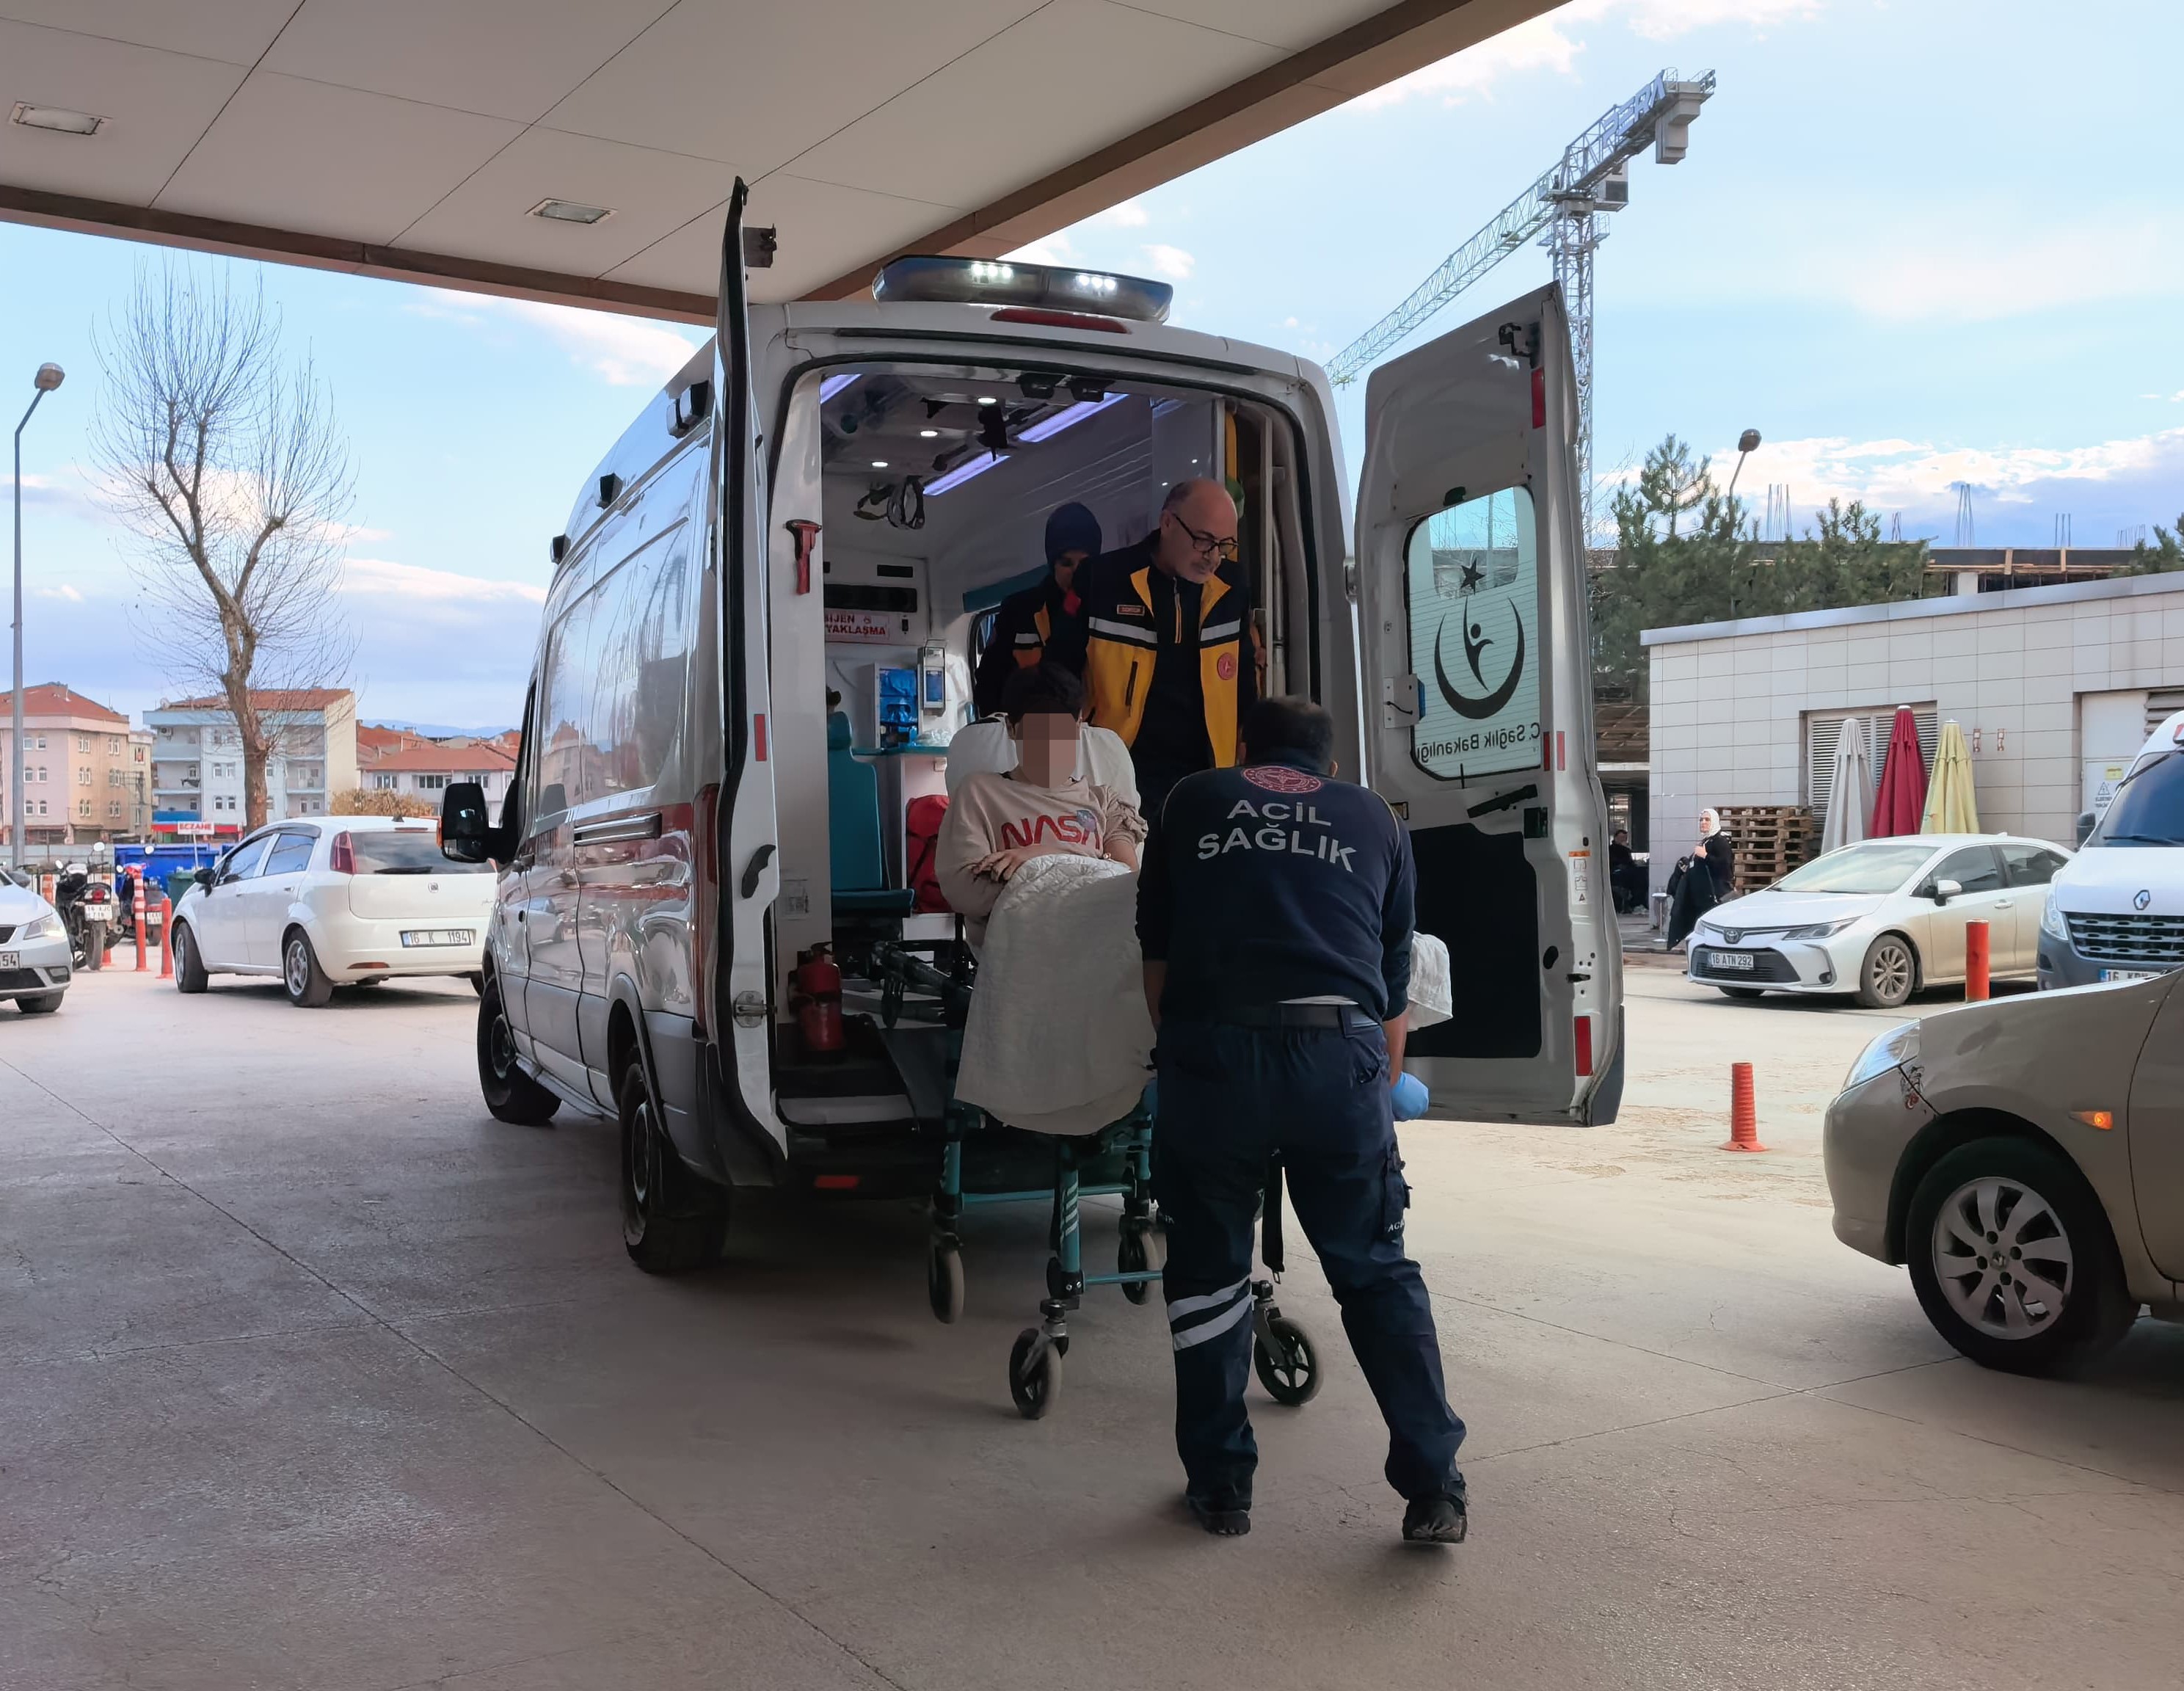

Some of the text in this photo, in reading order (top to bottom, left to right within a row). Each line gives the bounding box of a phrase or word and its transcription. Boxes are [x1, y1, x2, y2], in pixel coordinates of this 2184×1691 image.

[1226, 799, 1332, 827] ACİL
[1197, 822, 1358, 873] SAĞLIK
[410, 931, 468, 944] 16 K 1194
[0, 954, 16, 967] 54
[1712, 954, 1720, 964] 16
[1738, 956, 1752, 966] 292
